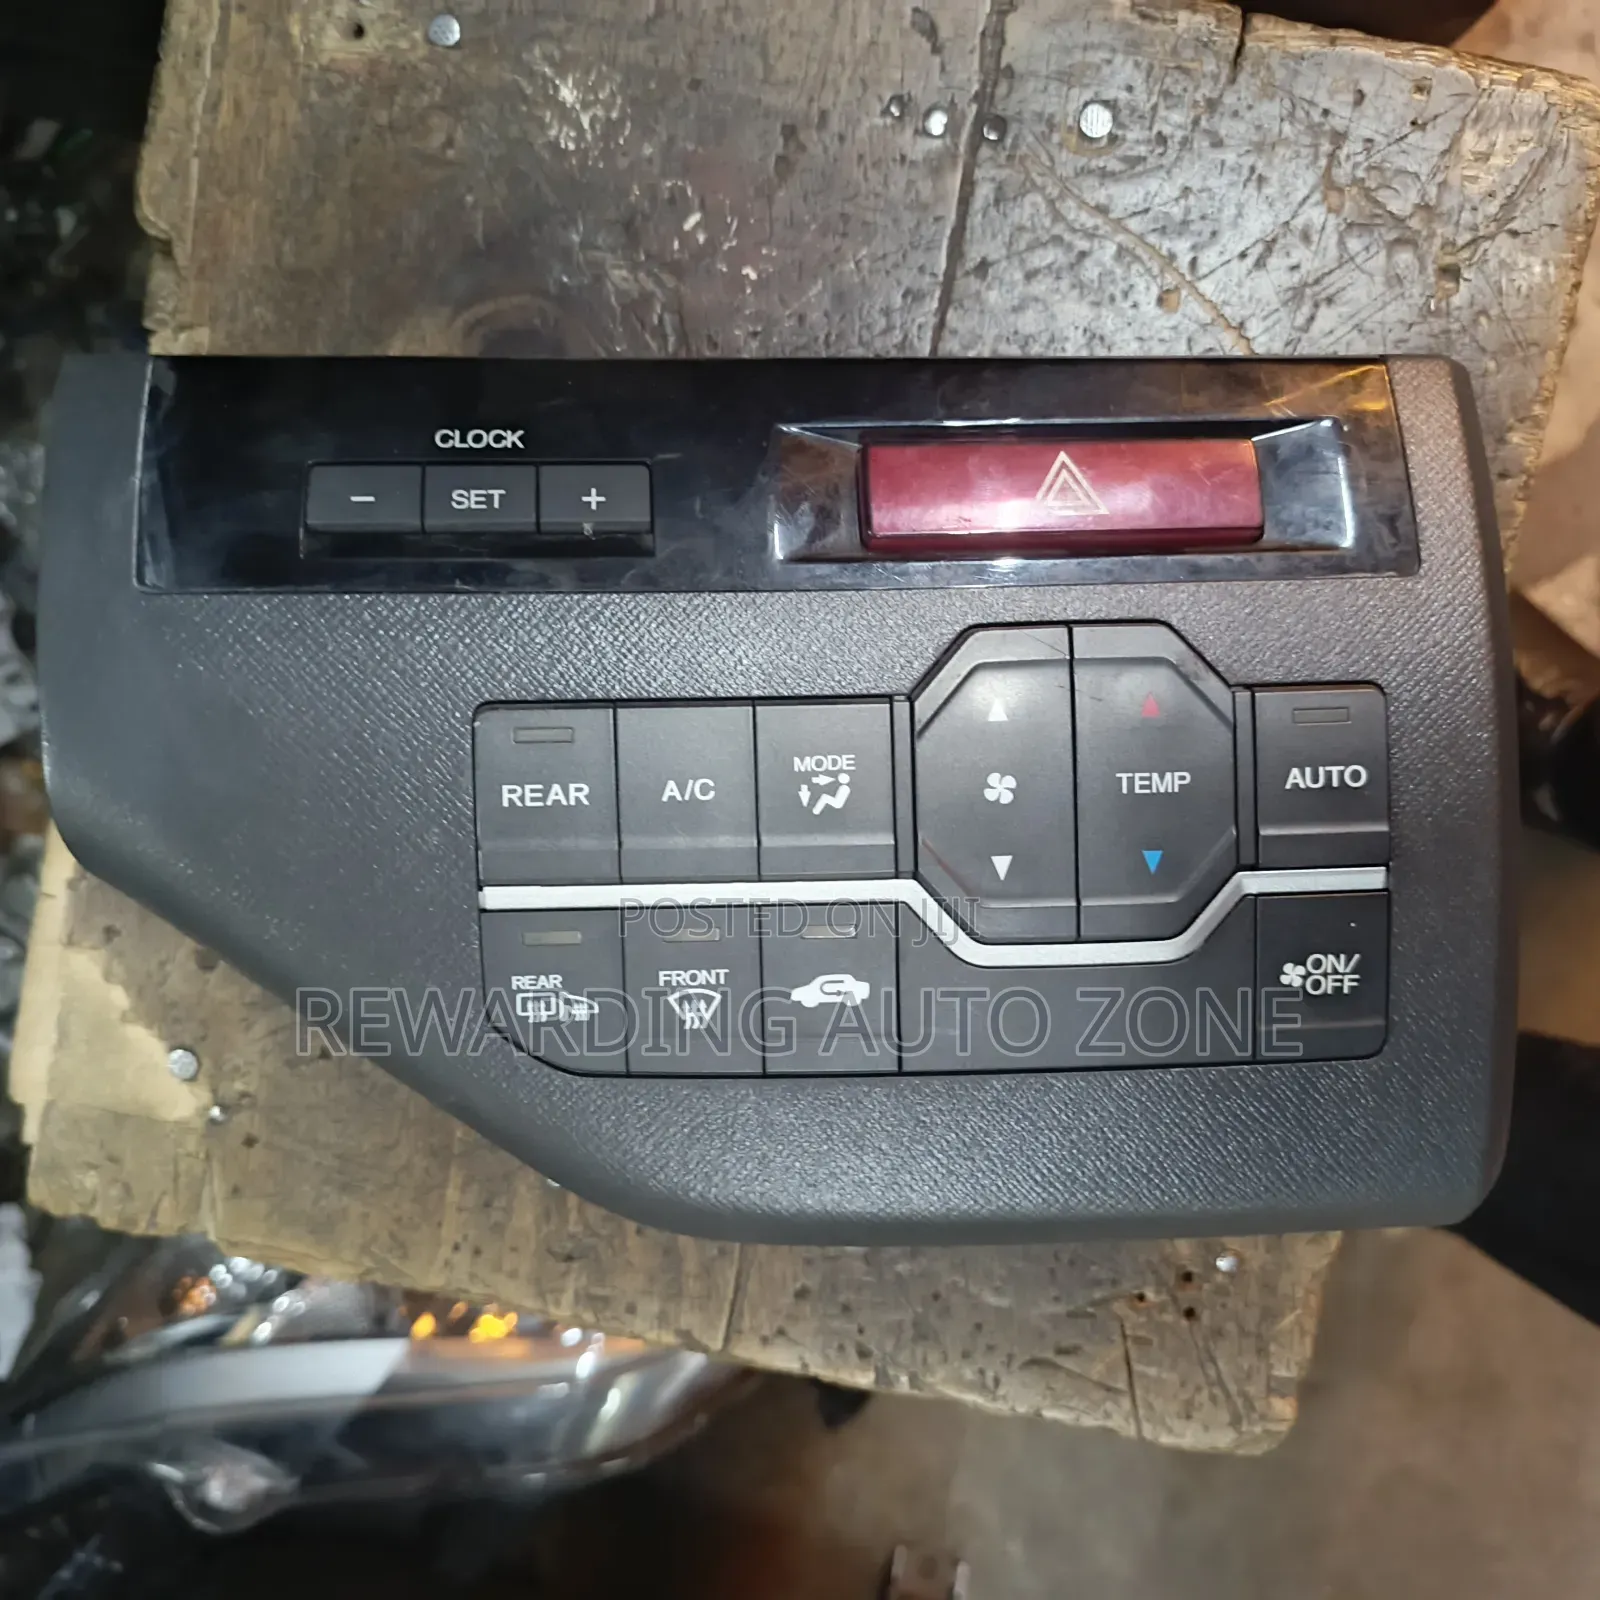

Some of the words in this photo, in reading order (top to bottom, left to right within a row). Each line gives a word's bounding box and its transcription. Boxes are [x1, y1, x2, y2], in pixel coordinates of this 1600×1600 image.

[434, 429, 525, 449] CLOCK
[450, 489, 506, 510] SET
[793, 754, 856, 772] MODE
[1115, 772, 1191, 794] TEMP
[1284, 765, 1368, 790] AUTO
[501, 783, 590, 807] REAR
[661, 778, 716, 802] A/C
[1305, 953, 1361, 974] ON/
[511, 974, 562, 990] REAR
[658, 969, 729, 987] FRONT
[1304, 974, 1361, 995] OFF
